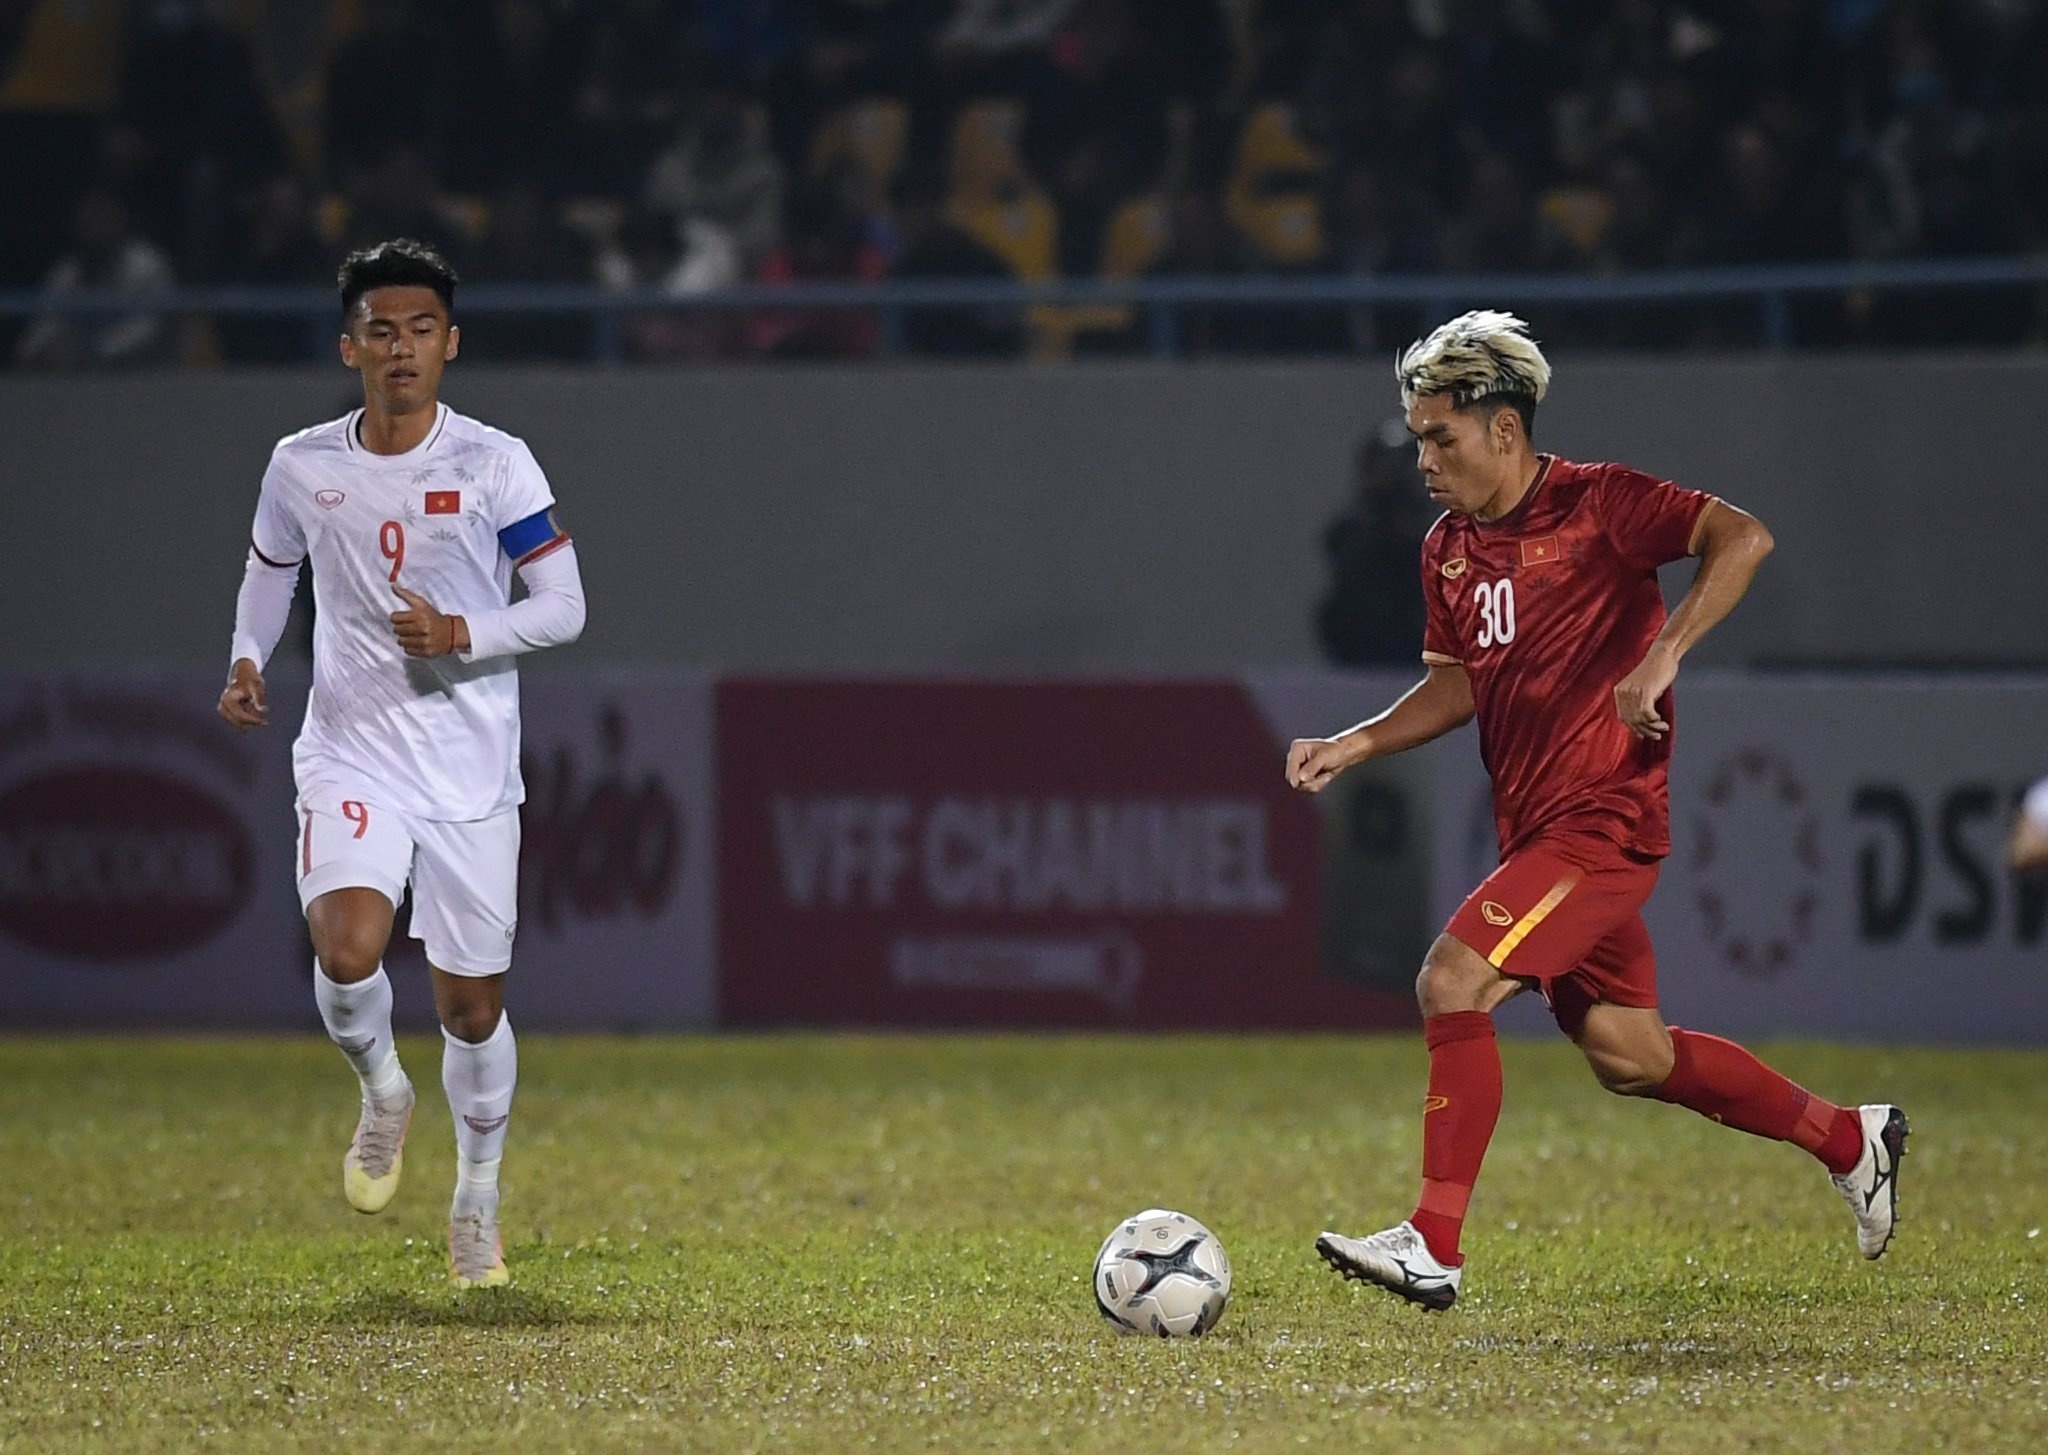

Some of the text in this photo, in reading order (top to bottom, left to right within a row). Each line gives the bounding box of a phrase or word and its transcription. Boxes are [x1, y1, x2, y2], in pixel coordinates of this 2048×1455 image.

[379, 520, 405, 583] 9
[1473, 578, 1516, 649] 30
[341, 800, 369, 840] 9
[773, 794, 1287, 910] VFF CHANNEL
